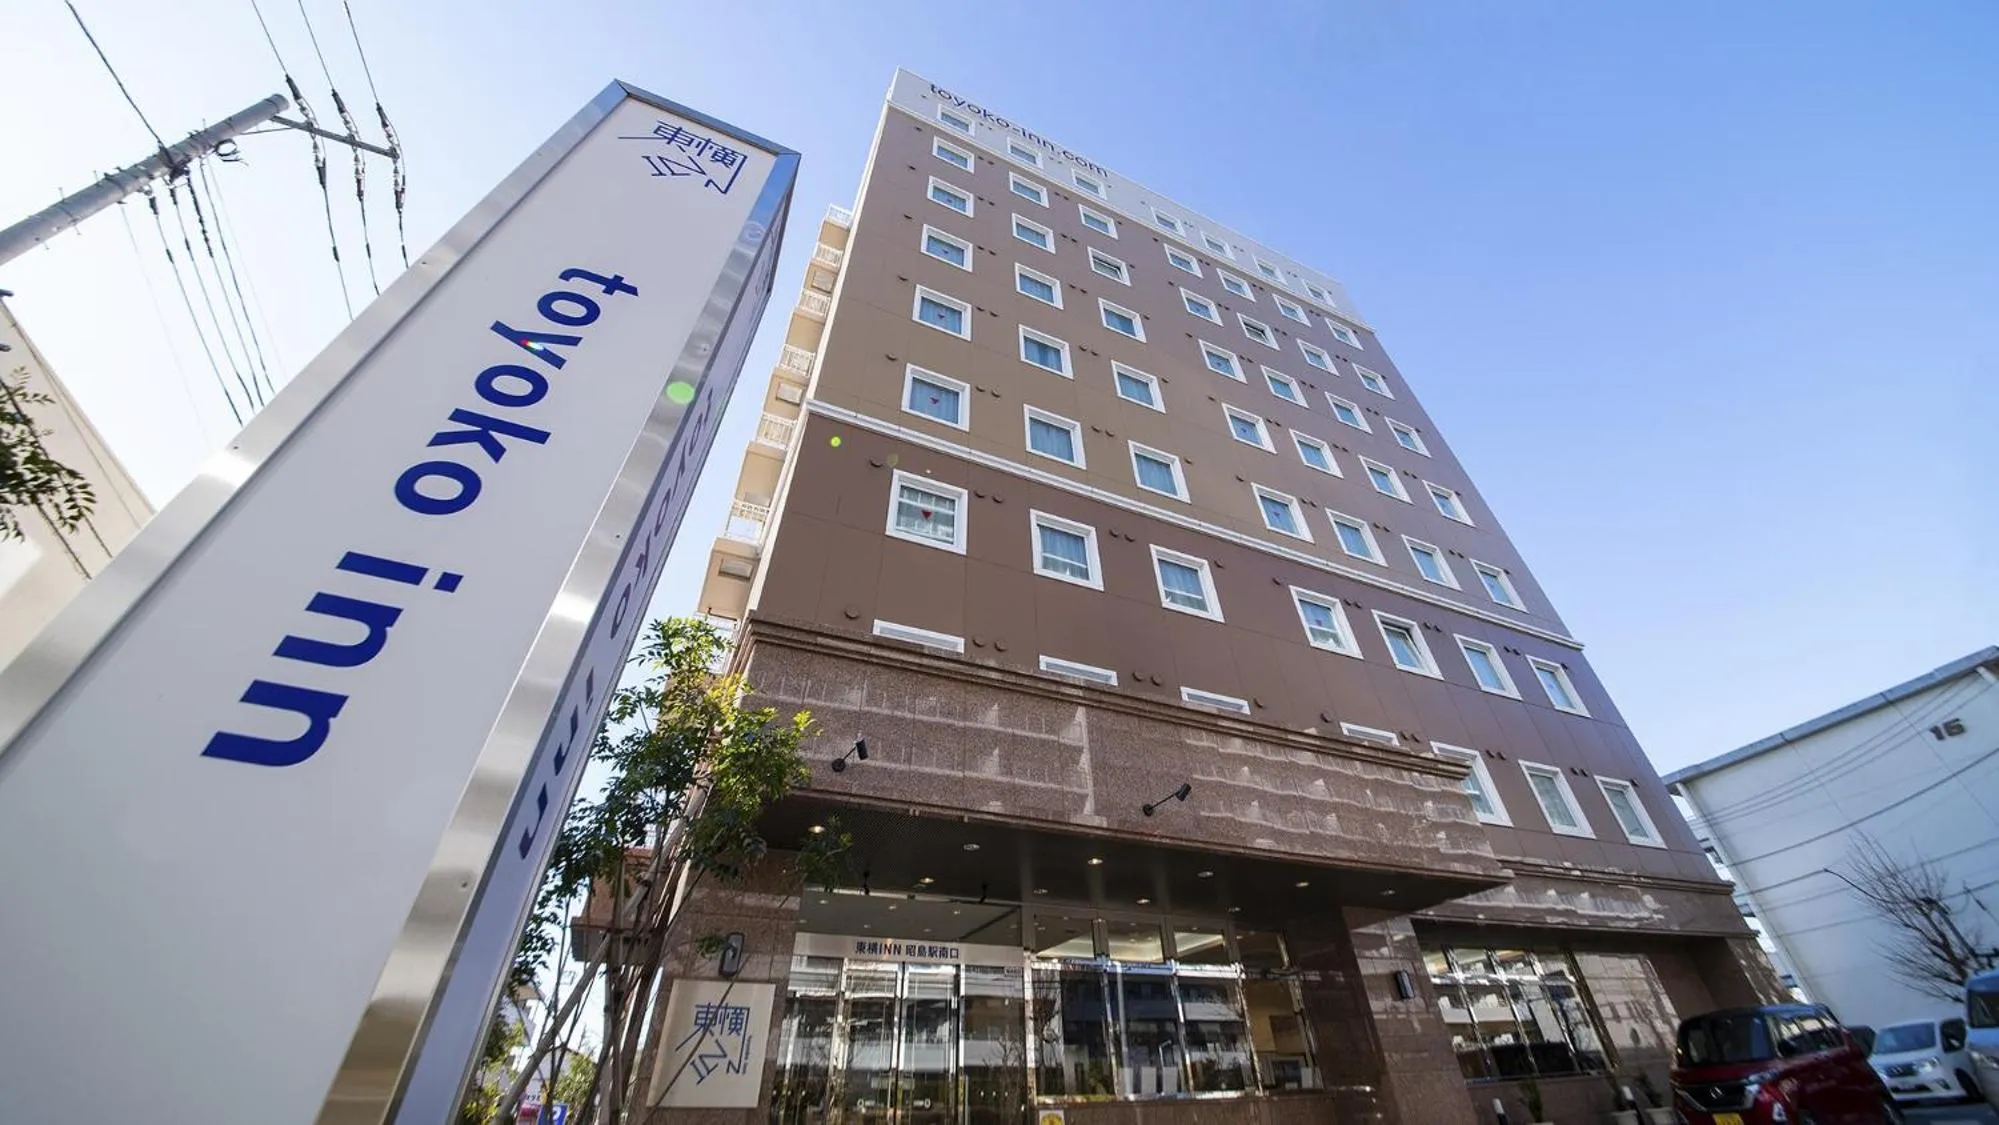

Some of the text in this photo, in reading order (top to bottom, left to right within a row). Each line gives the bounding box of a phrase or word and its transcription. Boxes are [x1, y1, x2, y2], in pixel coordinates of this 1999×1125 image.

[930, 83, 1108, 178] toyoko-inn.com
[201, 267, 639, 768] toyoko inn
